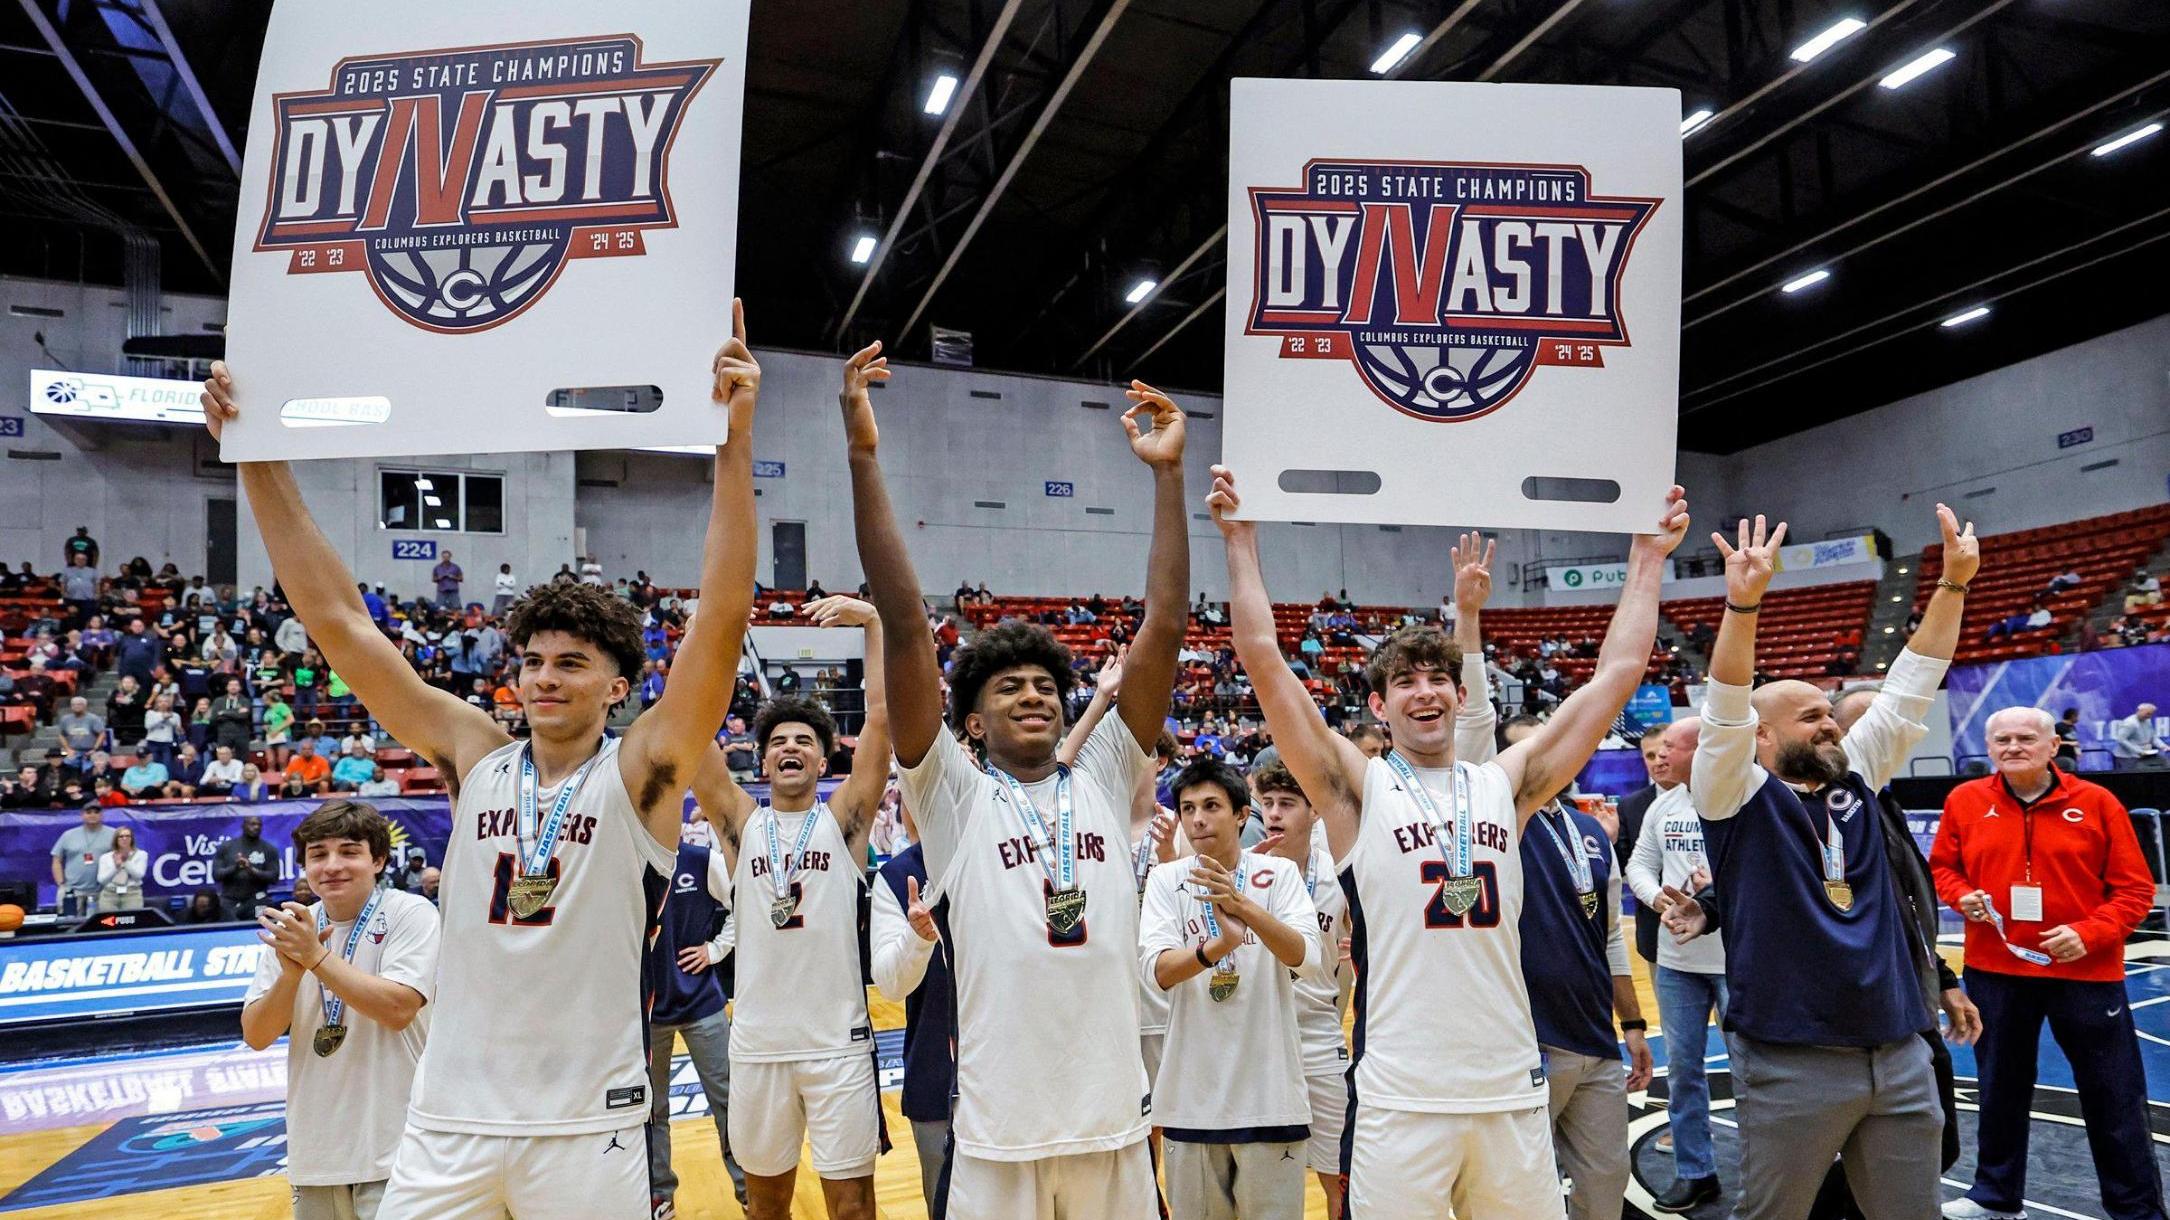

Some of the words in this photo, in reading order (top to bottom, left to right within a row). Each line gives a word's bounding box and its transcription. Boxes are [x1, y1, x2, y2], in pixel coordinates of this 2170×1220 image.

[345, 71, 399, 95] 2025
[412, 63, 479, 88] STATE
[492, 51, 624, 84] CHAMPIONS
[279, 89, 675, 231] DYNASTY
[1317, 175, 1368, 196] 2025
[1382, 176, 1443, 198] STATE
[1457, 178, 1575, 202] CHAMPIONS
[375, 235, 427, 250] COLUMBUS
[433, 232, 490, 246] EXPLORERS
[495, 228, 560, 243] BASKETBALL
[1267, 202, 1622, 327] DYNASTY
[1360, 331, 1408, 344] COLUMBUS
[1413, 333, 1466, 345] EXPLORERS
[1471, 335, 1529, 348] BASKETBALL
[130, 388, 206, 406] FLORID
[755, 463, 782, 476] 225
[1048, 483, 1070, 496] 226
[397, 543, 432, 558] 224
[477, 808, 597, 845] EXPERS
[540, 785, 574, 858] BASKETBALL
[1393, 820, 1508, 855] EXPERS
[997, 832, 1106, 870] EXPERS
[1062, 811, 1070, 883] BASKETBALL
[1421, 861, 1501, 929] 20
[1, 949, 194, 993] BASKETBALL
[633, 1092, 642, 1100] XL
